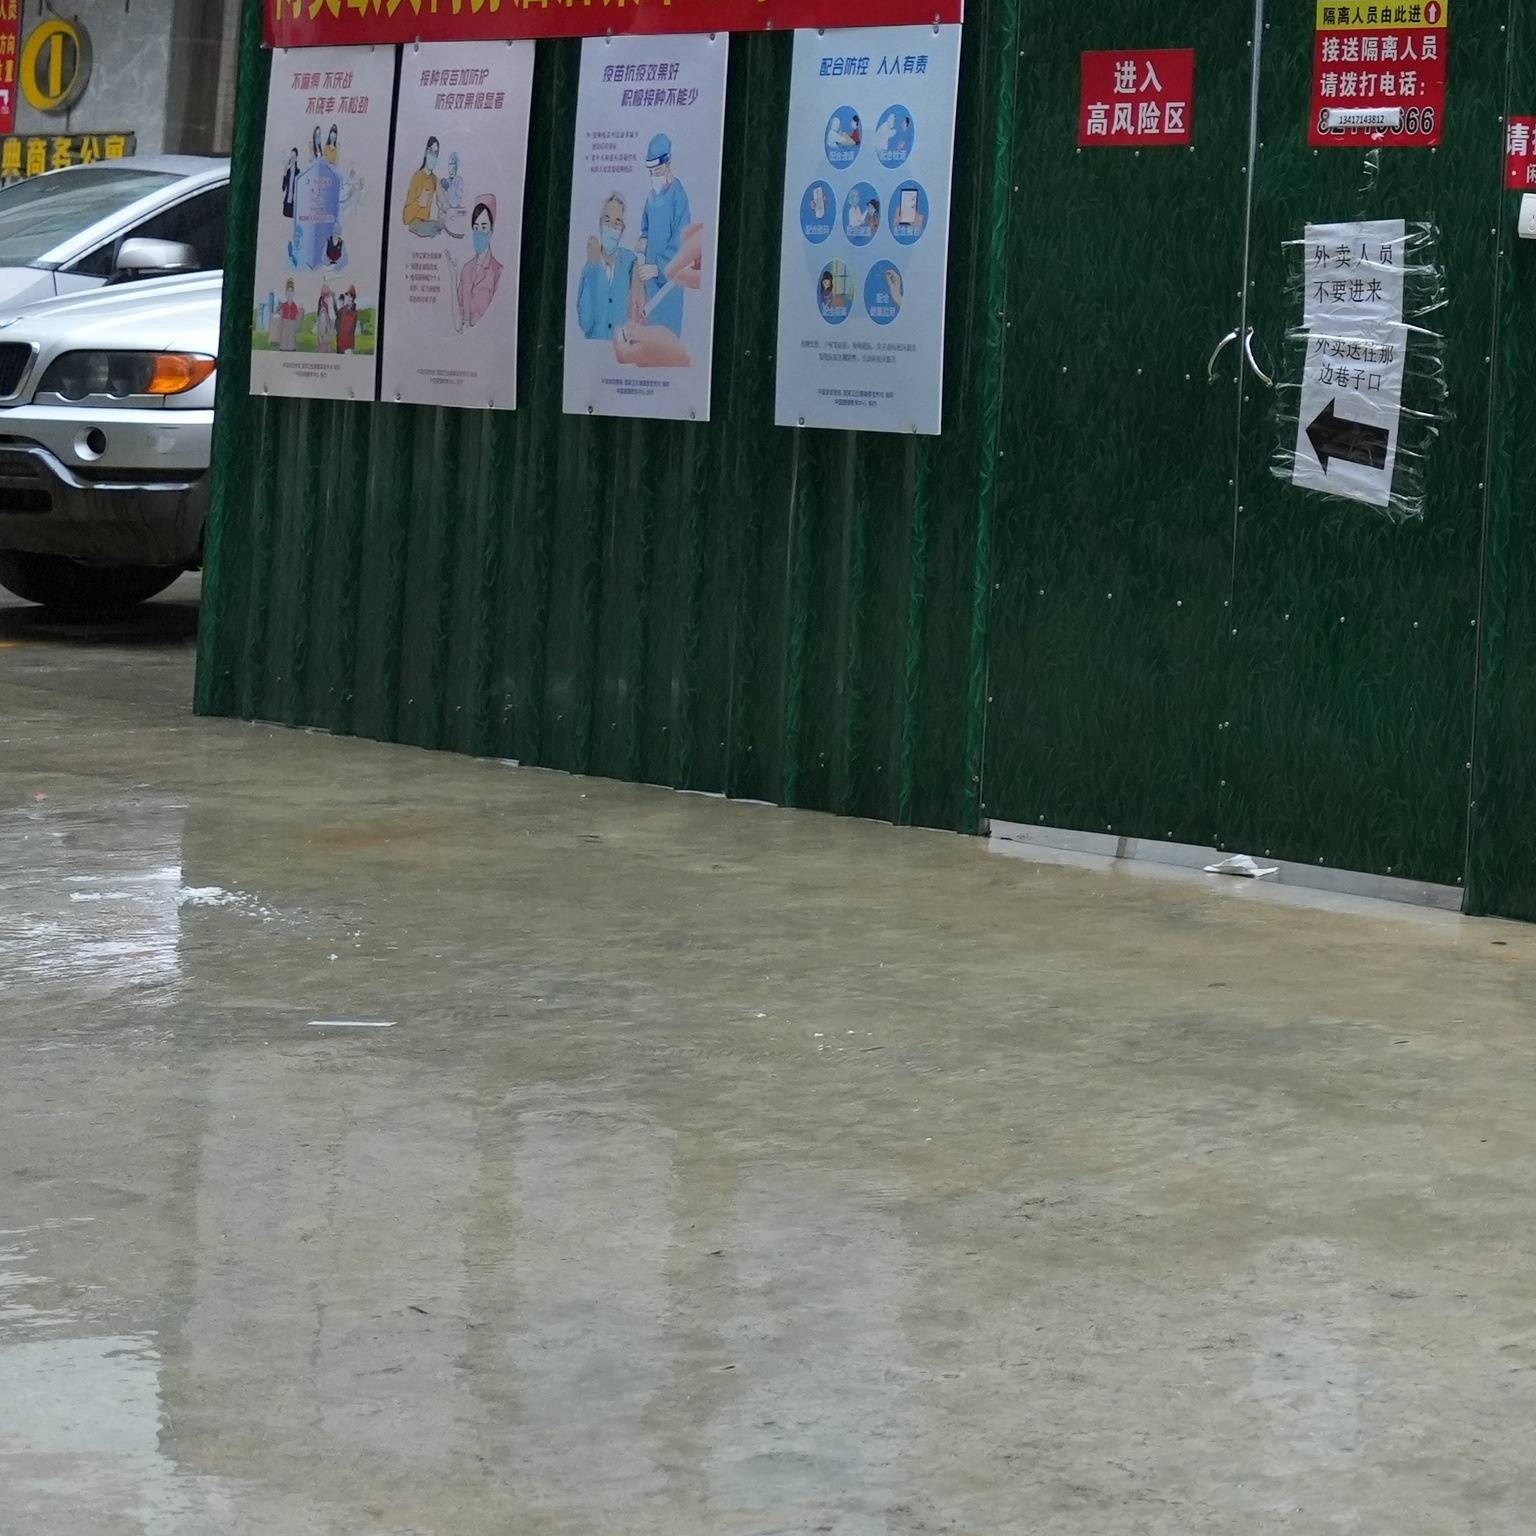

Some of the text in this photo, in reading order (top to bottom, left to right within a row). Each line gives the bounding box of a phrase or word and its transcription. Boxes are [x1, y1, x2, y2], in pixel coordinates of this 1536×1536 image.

[1323, 4, 1422, 26] 隔离人员由此进
[1321, 35, 1439, 62] 接送隔离人员
[602, 62, 680, 83] 疫苗抗疫效果好
[819, 54, 929, 77] 配合防控 人人有责
[1113, 61, 1163, 95] 进入
[621, 87, 699, 107] 积极接种不能少
[1086, 100, 1187, 136] 高风险区
[1338, 114, 1385, 125] 13417143812
[1313, 242, 1394, 268] 外卖人员
[1313, 277, 1383, 304] 不要进来
[1318, 363, 1382, 392] 边巷子口
